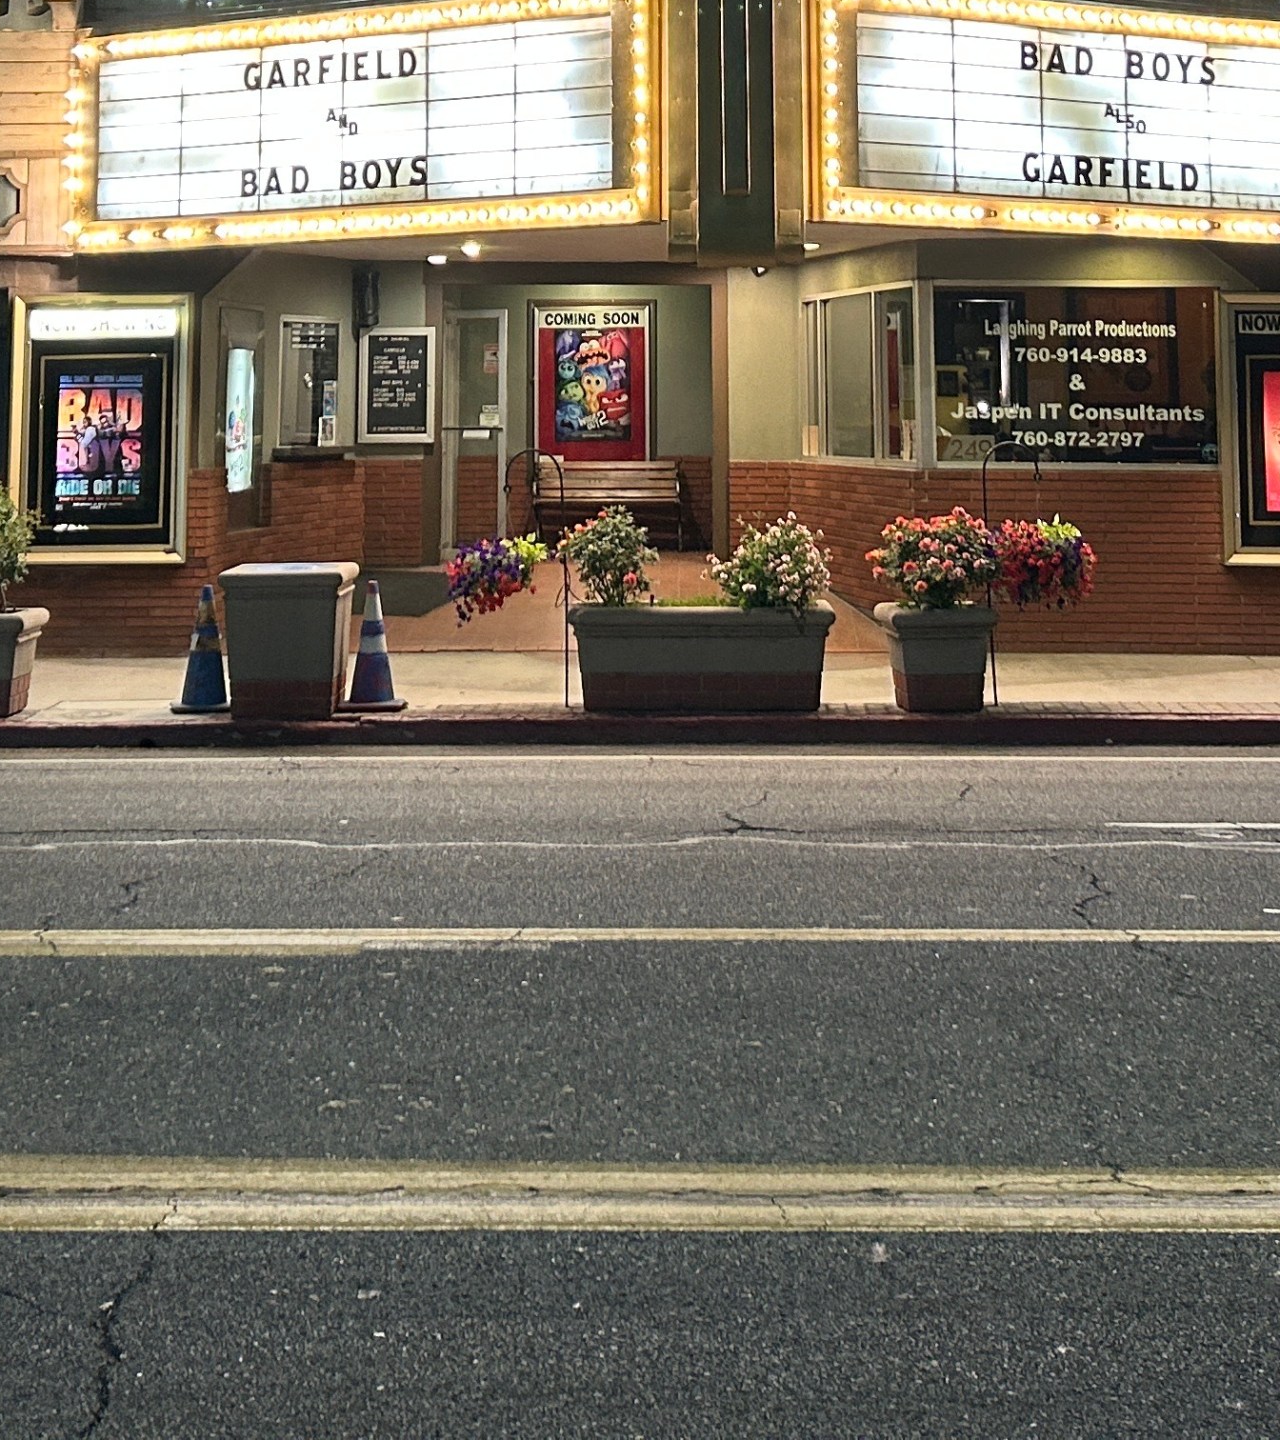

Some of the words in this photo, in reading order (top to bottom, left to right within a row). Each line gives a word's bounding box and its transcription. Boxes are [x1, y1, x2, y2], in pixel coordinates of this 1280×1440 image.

[243, 47, 418, 91] GARFIELD
[1019, 39, 1094, 75] BAD
[1126, 49, 1216, 86] BOYS
[325, 108, 359, 136] AND
[240, 164, 310, 198] BAD
[339, 155, 428, 191] BOYS
[1022, 152, 1199, 192] GARFIELD
[545, 312, 597, 326] COMING
[603, 312, 640, 326] SOON
[983, 319, 1047, 340] Laghing
[1049, 319, 1092, 337] Parrot
[1095, 319, 1177, 338] Productions
[1014, 347, 1148, 364] 760-914-9883
[1069, 373, 1086, 391] &
[57, 389, 143, 432] BAD
[1039, 402, 1062, 420] IT
[1069, 402, 1206, 422] Consultants
[950, 439, 993, 460] 249
[1011, 430, 1145, 448] 760-872-2797
[56, 438, 142, 473] BOYS
[93, 479, 113, 496] OR
[117, 479, 141, 496] DIE
